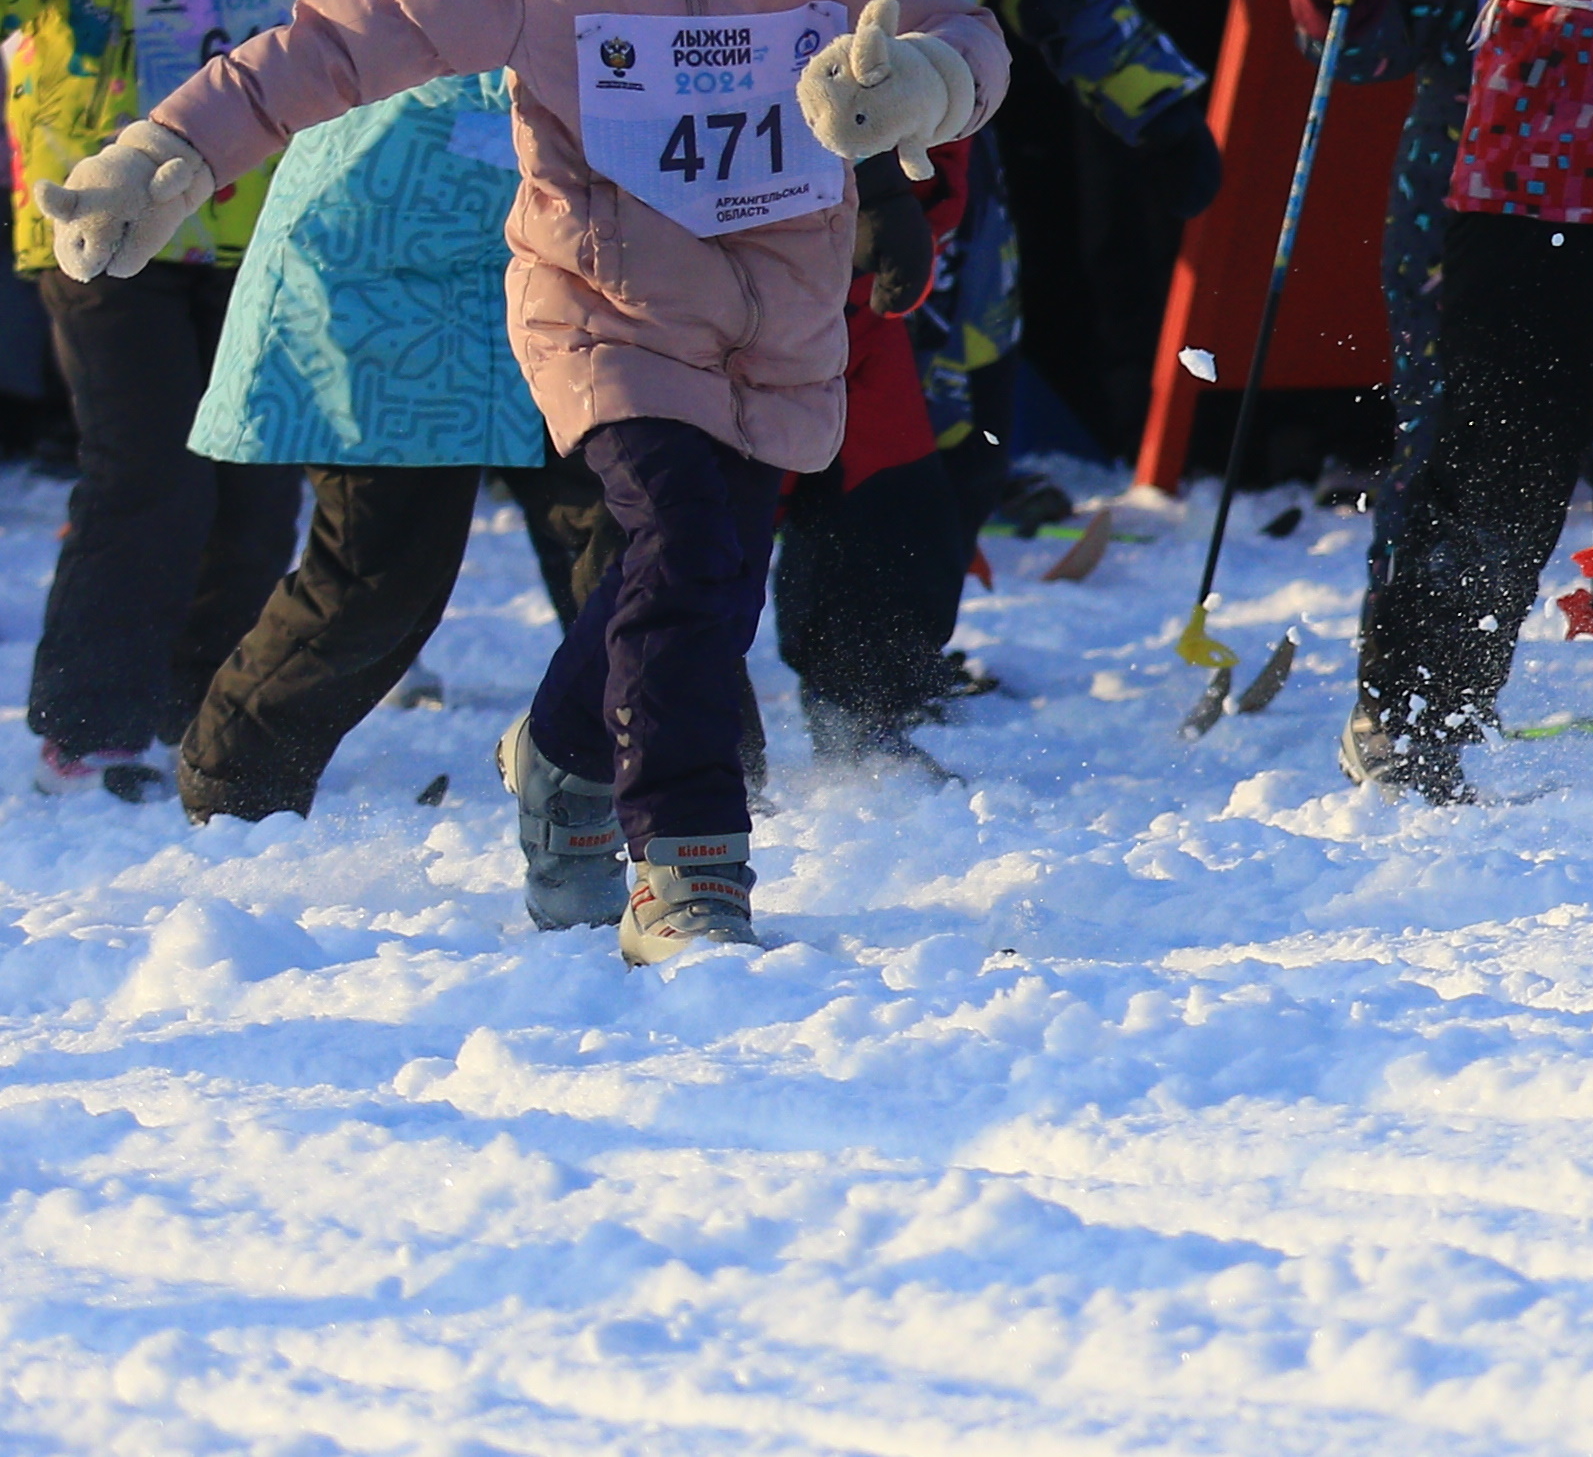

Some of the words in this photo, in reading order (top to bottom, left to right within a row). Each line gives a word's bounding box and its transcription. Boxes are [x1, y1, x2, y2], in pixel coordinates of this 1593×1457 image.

[671, 28, 751, 48] ЛЫЖНЯ
[673, 45, 751, 68] РОССИИ
[674, 71, 755, 94] 2024
[659, 103, 784, 183] 471
[715, 184, 810, 209] АРХАНГЕЛЬСКАЯ
[716, 204, 770, 223] ОБЛАСТЬ
[677, 844, 728, 858] KidBoot
[691, 882, 747, 901] NORDWAY
